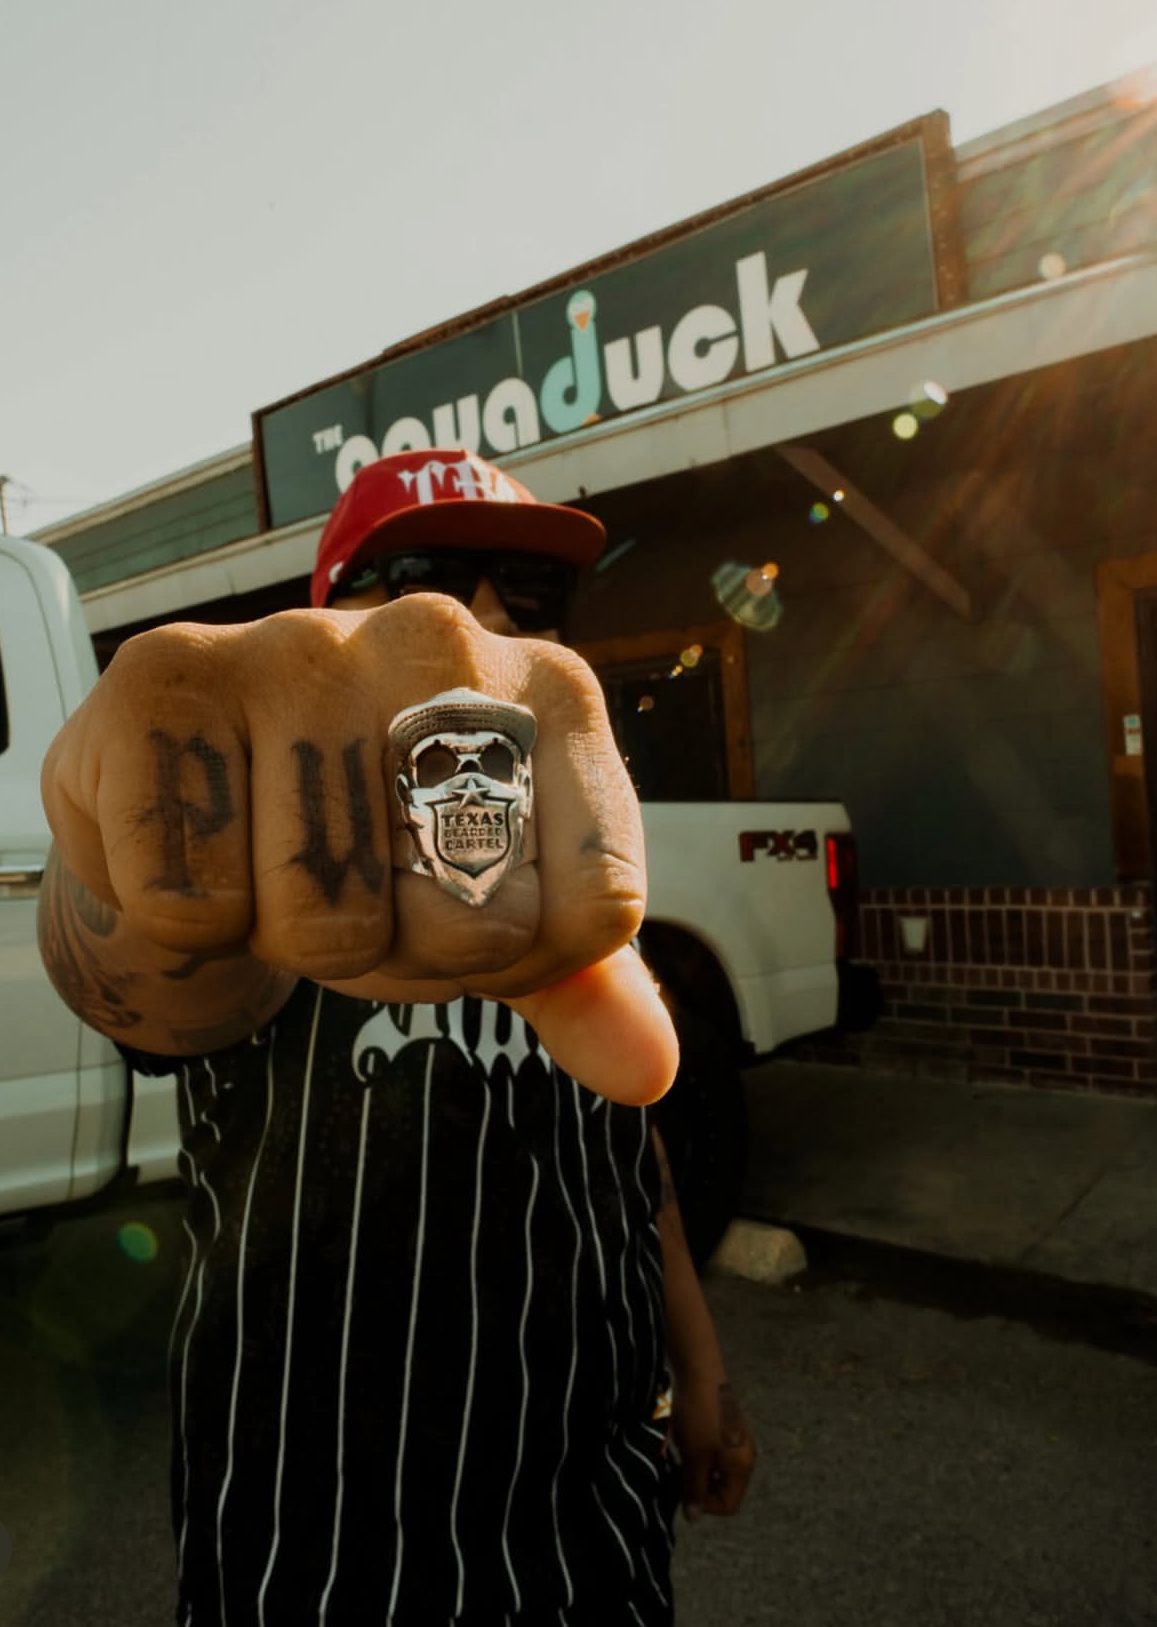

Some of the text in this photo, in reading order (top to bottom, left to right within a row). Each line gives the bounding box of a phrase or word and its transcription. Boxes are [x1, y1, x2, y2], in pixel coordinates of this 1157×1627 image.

[313, 424, 343, 454] THE
[440, 812, 504, 828] TEXAS
[445, 838, 504, 850] CARTEL
